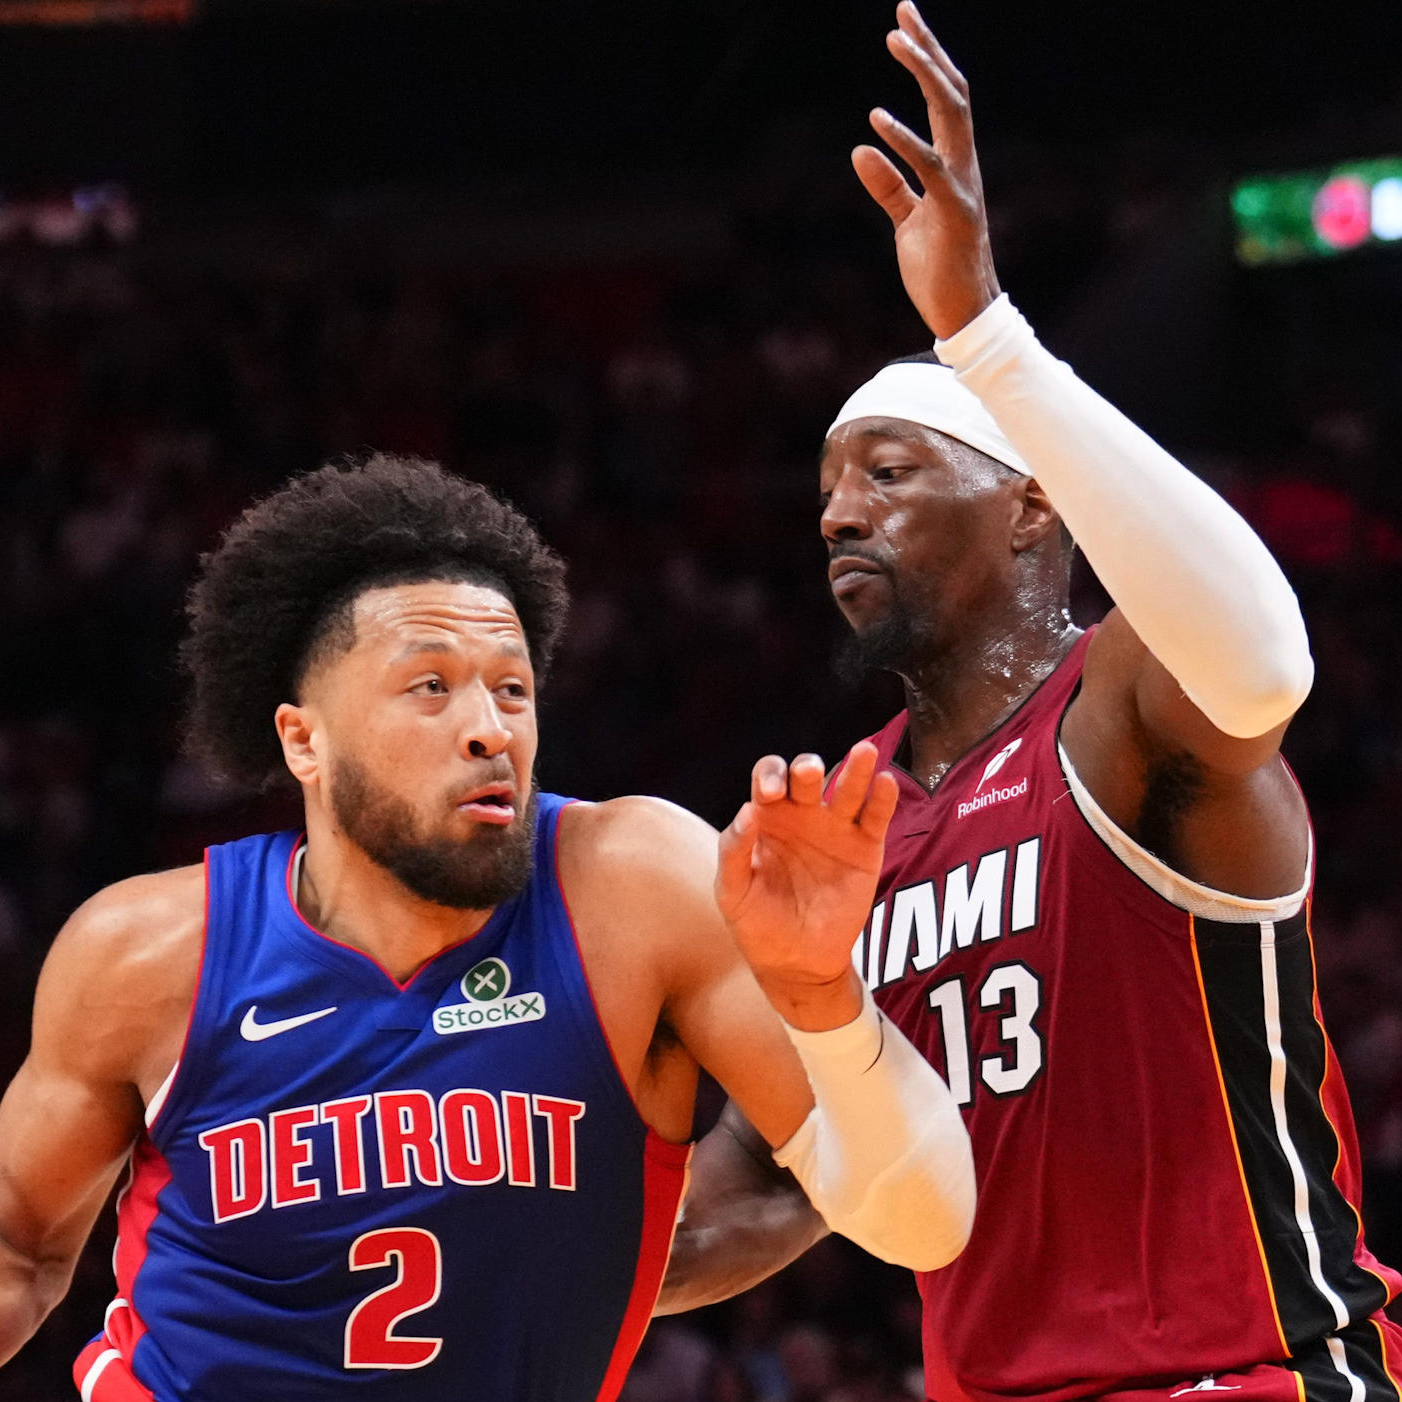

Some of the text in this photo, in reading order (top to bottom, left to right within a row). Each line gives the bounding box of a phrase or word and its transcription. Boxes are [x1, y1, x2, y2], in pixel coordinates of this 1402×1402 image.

[957, 777, 1027, 819] Robinhood
[851, 835, 1042, 993] IAMI
[438, 996, 541, 1029] StockX
[928, 959, 1047, 1108] 13
[199, 1088, 586, 1224] DETROIT
[344, 1226, 443, 1370] 2
